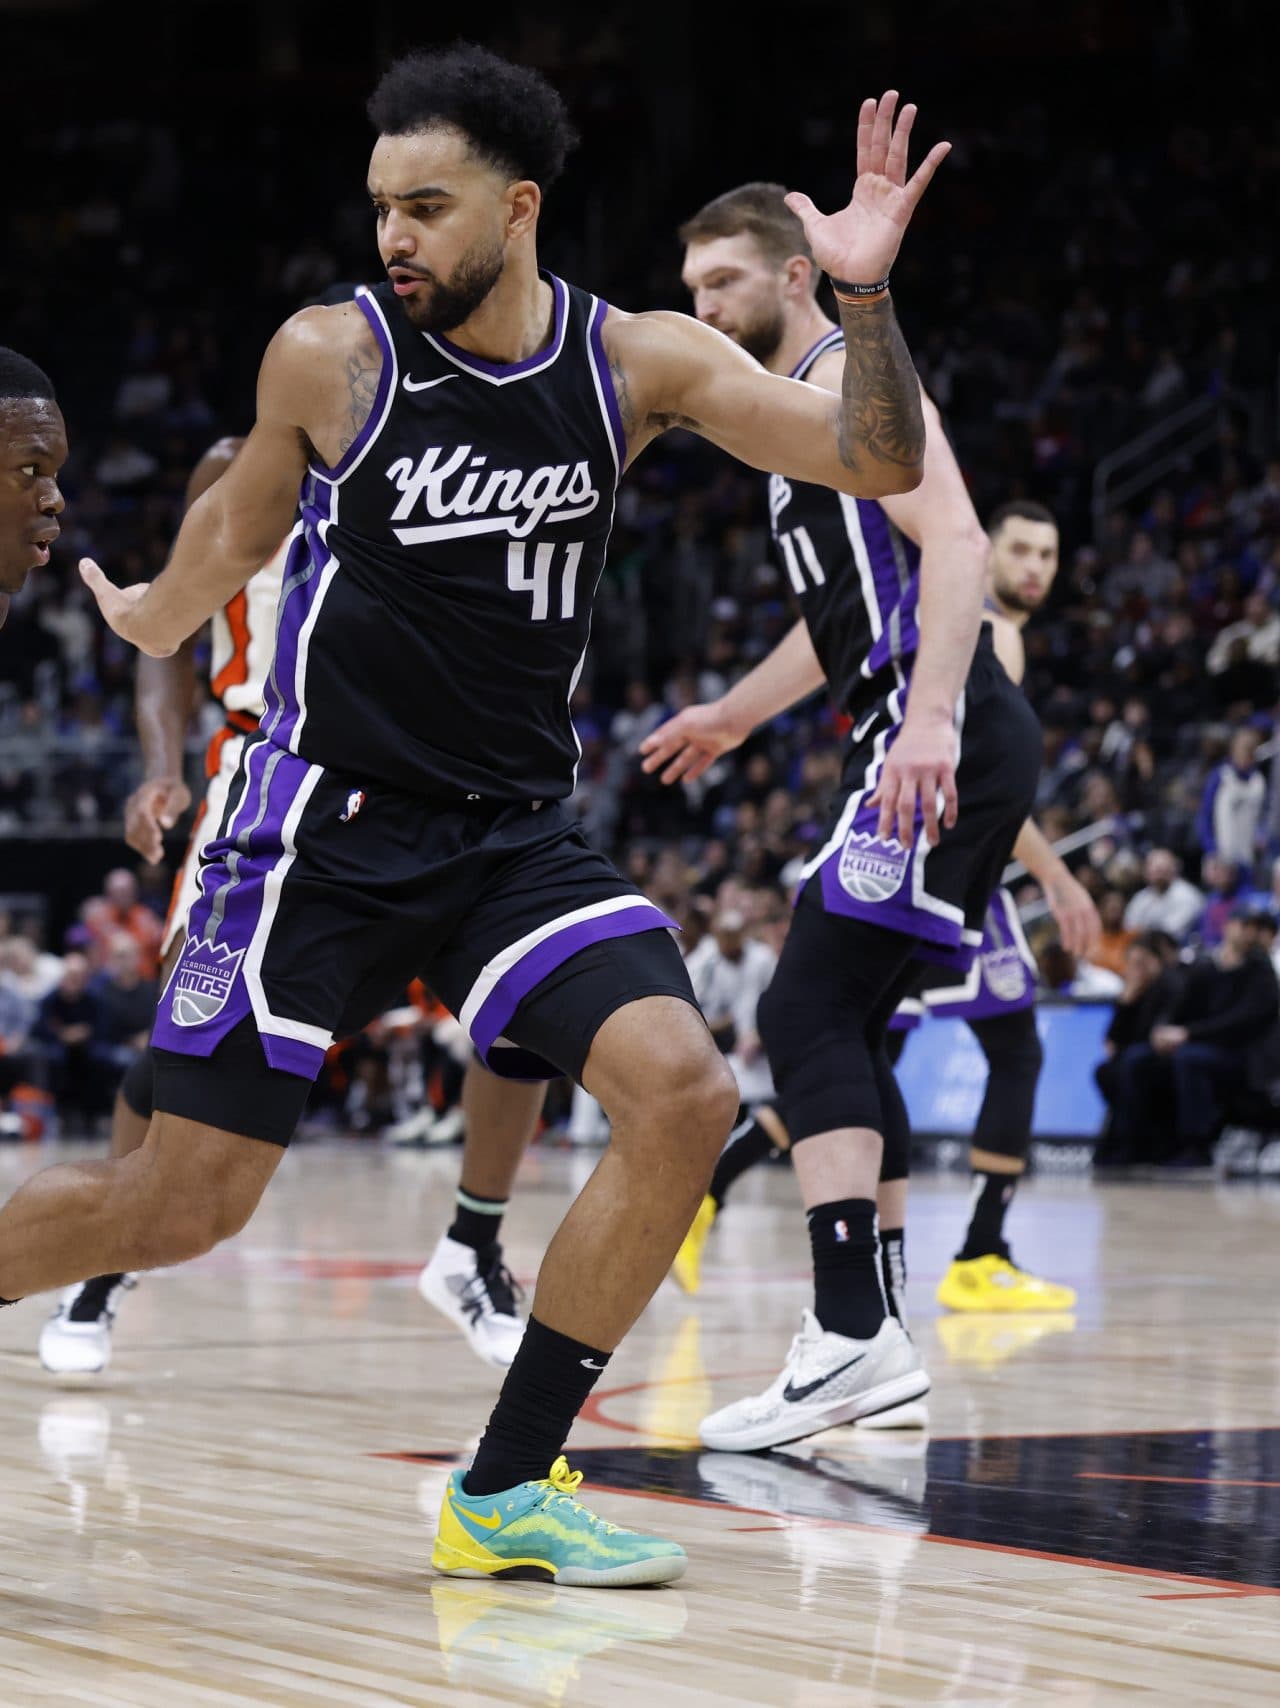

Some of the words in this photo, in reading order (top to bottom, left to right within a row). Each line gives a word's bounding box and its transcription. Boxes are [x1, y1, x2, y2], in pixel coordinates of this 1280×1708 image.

[859, 286, 876, 294] love
[385, 445, 600, 546] Kings
[507, 541, 584, 621] 41
[778, 525, 826, 594] 11
